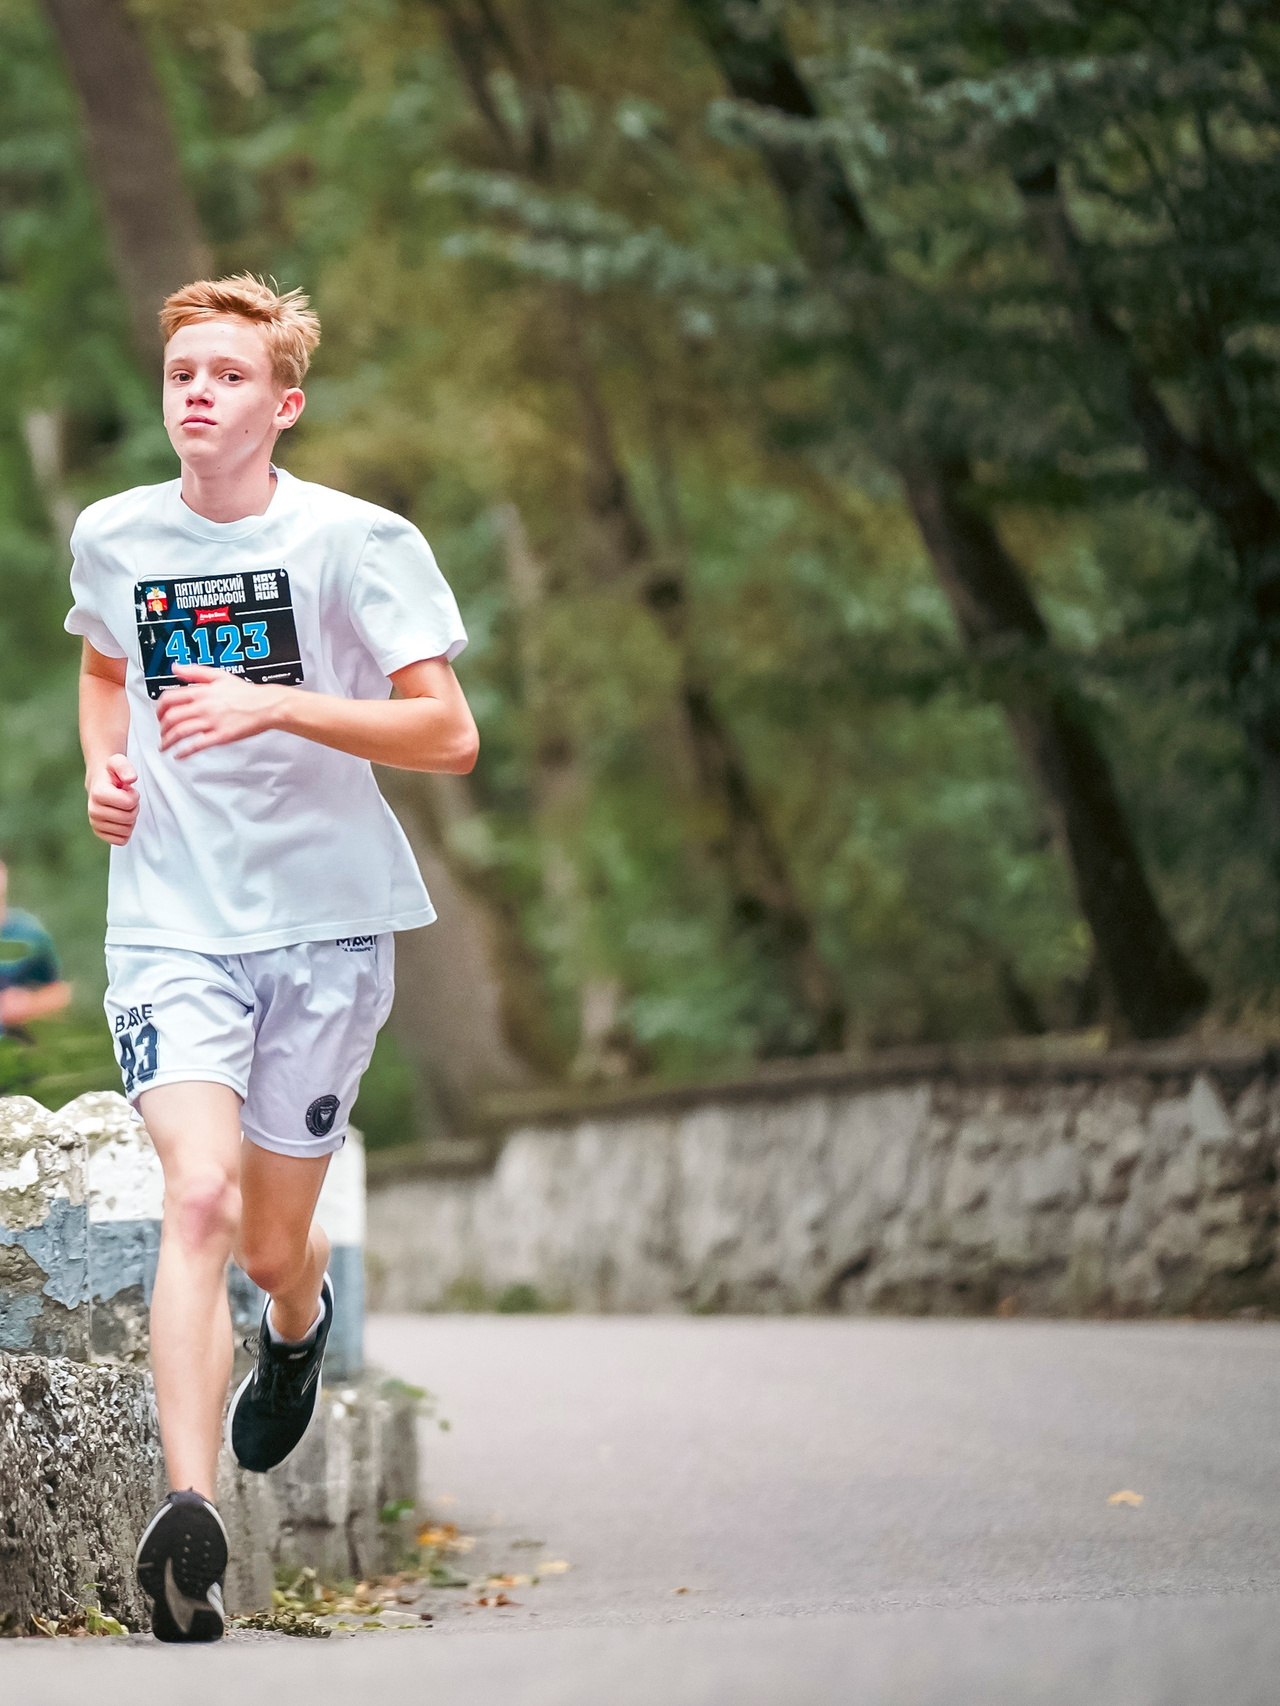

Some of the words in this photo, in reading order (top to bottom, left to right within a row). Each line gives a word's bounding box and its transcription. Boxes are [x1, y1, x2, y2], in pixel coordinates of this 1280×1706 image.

[174, 574, 244, 597] ПЯТИГОРСКИЙ
[176, 590, 246, 609] ПОЛУМАРАФОН
[165, 621, 270, 665] 4123
